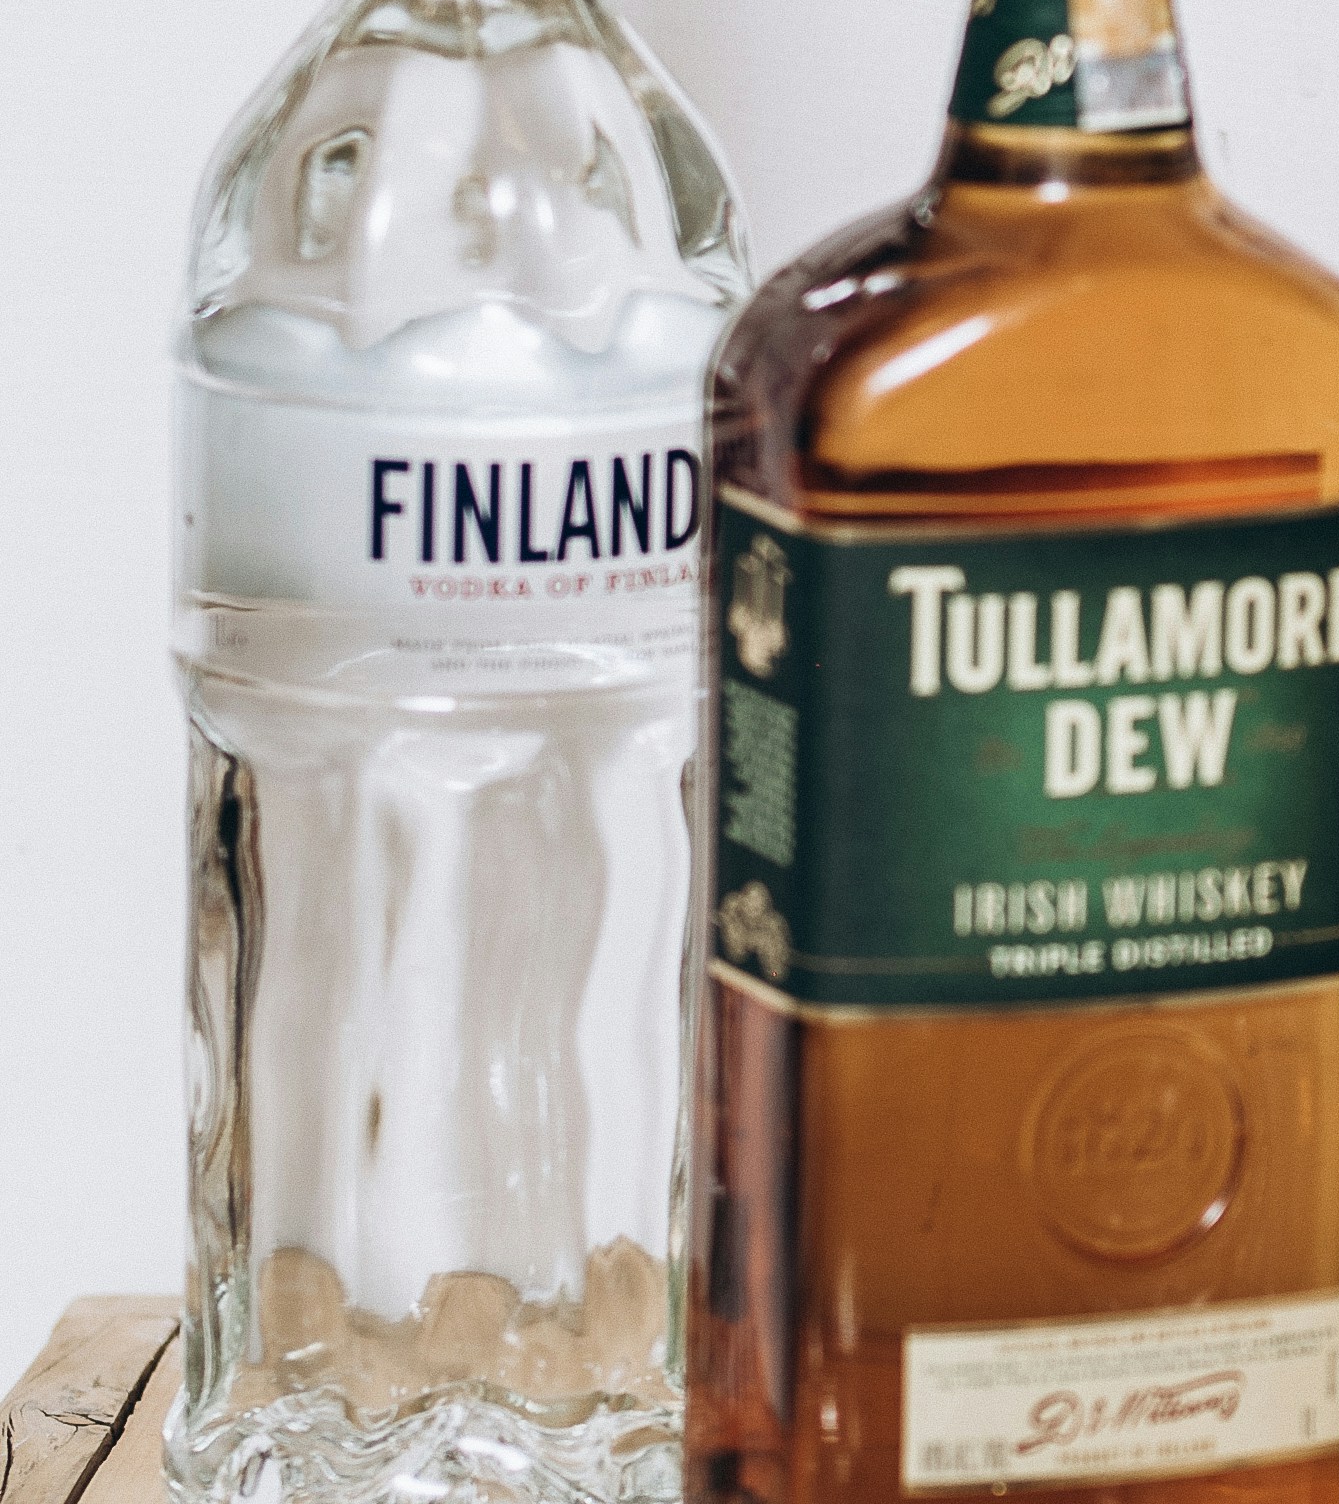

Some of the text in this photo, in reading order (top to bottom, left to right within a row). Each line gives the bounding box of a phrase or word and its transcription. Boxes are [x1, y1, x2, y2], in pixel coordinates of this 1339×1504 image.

[409, 575, 533, 601] VODKA
[548, 572, 593, 600] OF
[1043, 689, 1238, 798] DEW
[952, 858, 1309, 938] IRISH WHISKEY
